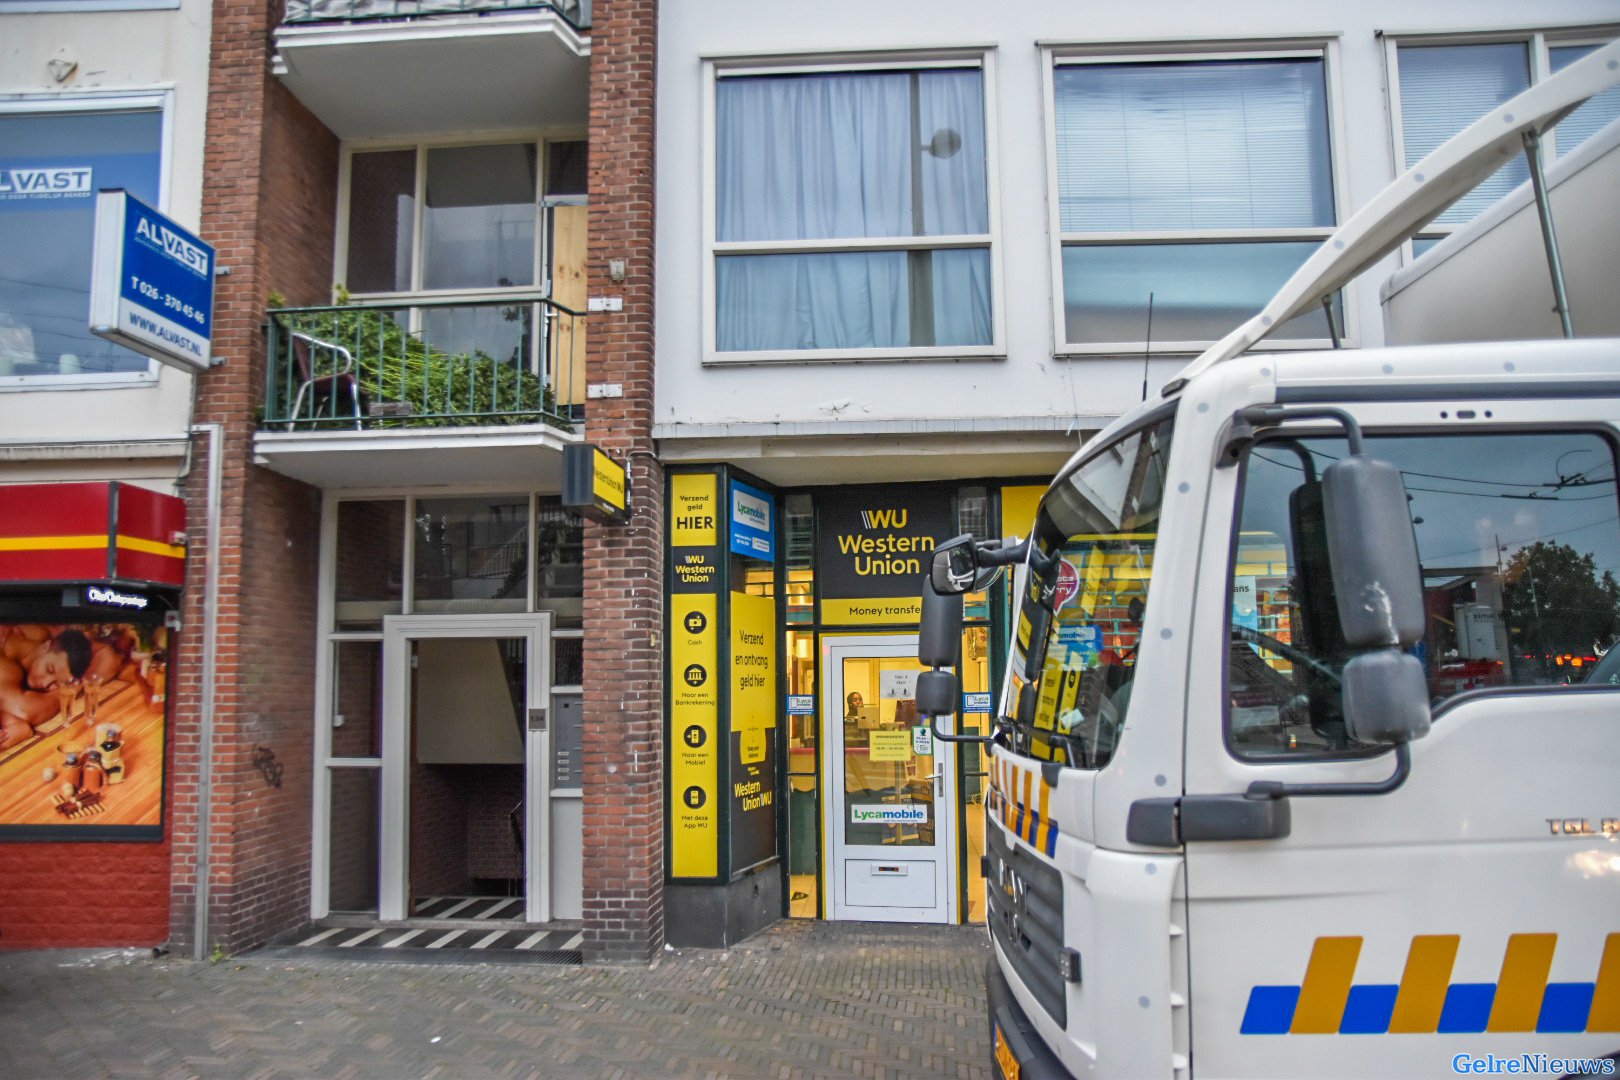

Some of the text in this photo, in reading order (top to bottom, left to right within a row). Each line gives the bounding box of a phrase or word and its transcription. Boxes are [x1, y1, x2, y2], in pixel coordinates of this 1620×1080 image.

[0, 171, 89, 191] LVAST
[136, 217, 206, 272] ALVAST
[131, 276, 139, 289] T
[139, 281, 159, 300] 026
[676, 516, 714, 530] HIER
[866, 509, 907, 529] WU
[838, 533, 935, 554] Western
[687, 555, 704, 564] WU
[854, 554, 920, 576] Union
[675, 565, 715, 574] Western
[681, 574, 709, 582] Union
[1233, 585, 1250, 593] ans
[849, 605, 921, 616] Money transfe
[740, 630, 764, 646] Verzend
[735, 654, 768, 670] en ontvang
[740, 674, 766, 691] geld hier
[734, 781, 761, 798] Western
[742, 791, 772, 812] Union WU
[854, 809, 924, 820] Lycamobile
